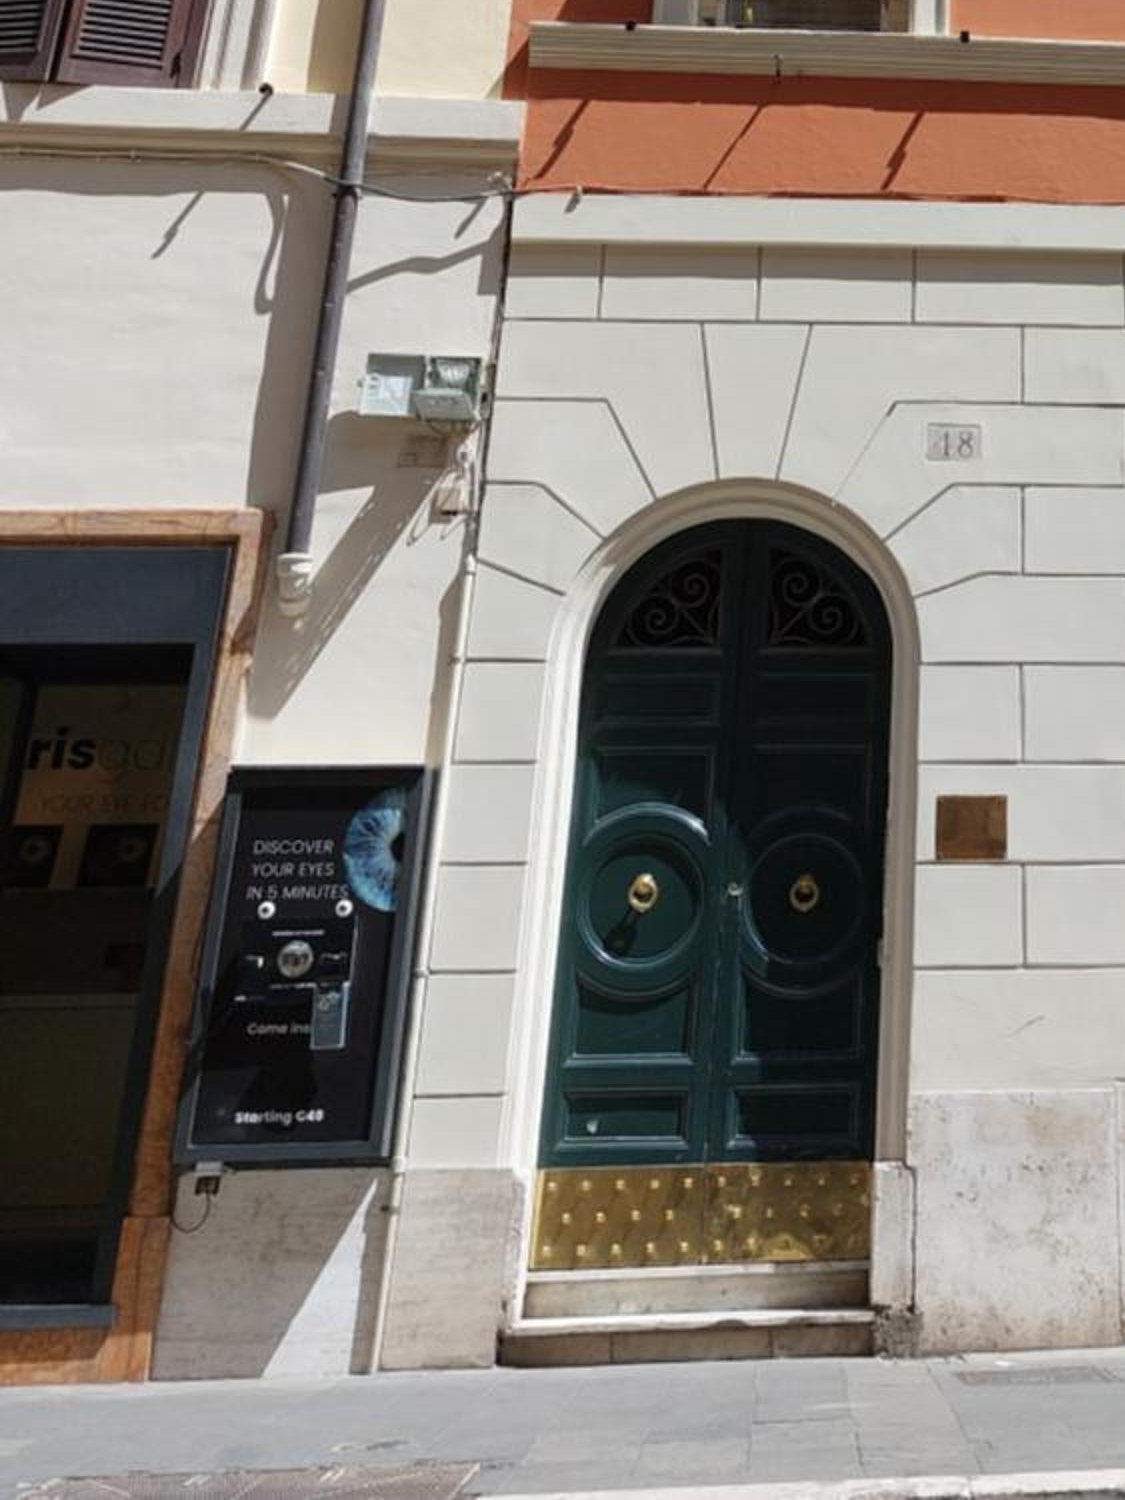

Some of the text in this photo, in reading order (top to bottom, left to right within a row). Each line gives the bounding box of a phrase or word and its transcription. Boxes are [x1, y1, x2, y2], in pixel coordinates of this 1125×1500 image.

[943, 430, 974, 458] 18
[252, 839, 335, 854] DISCOVER
[251, 861, 335, 877] YOUR EYES
[246, 884, 350, 900] IN 5 MINUTES
[234, 1109, 293, 1127] Starting
